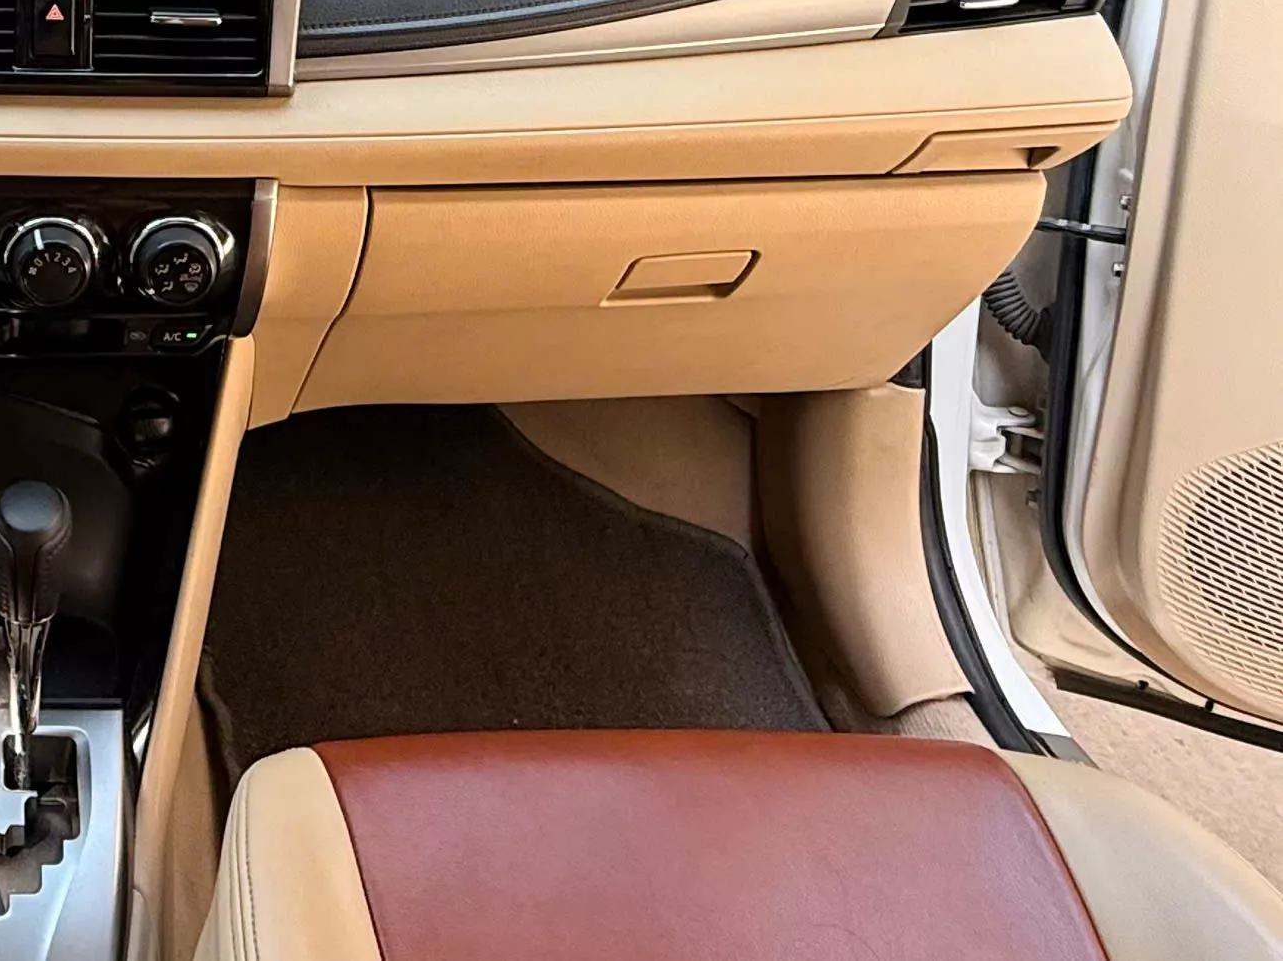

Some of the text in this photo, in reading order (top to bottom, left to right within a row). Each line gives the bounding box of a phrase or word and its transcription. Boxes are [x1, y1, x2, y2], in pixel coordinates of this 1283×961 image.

[33, 258, 44, 267] 0
[44, 252, 51, 263] 1
[53, 252, 62, 263] 2
[61, 257, 71, 267] 3
[163, 332, 182, 342] A/C
